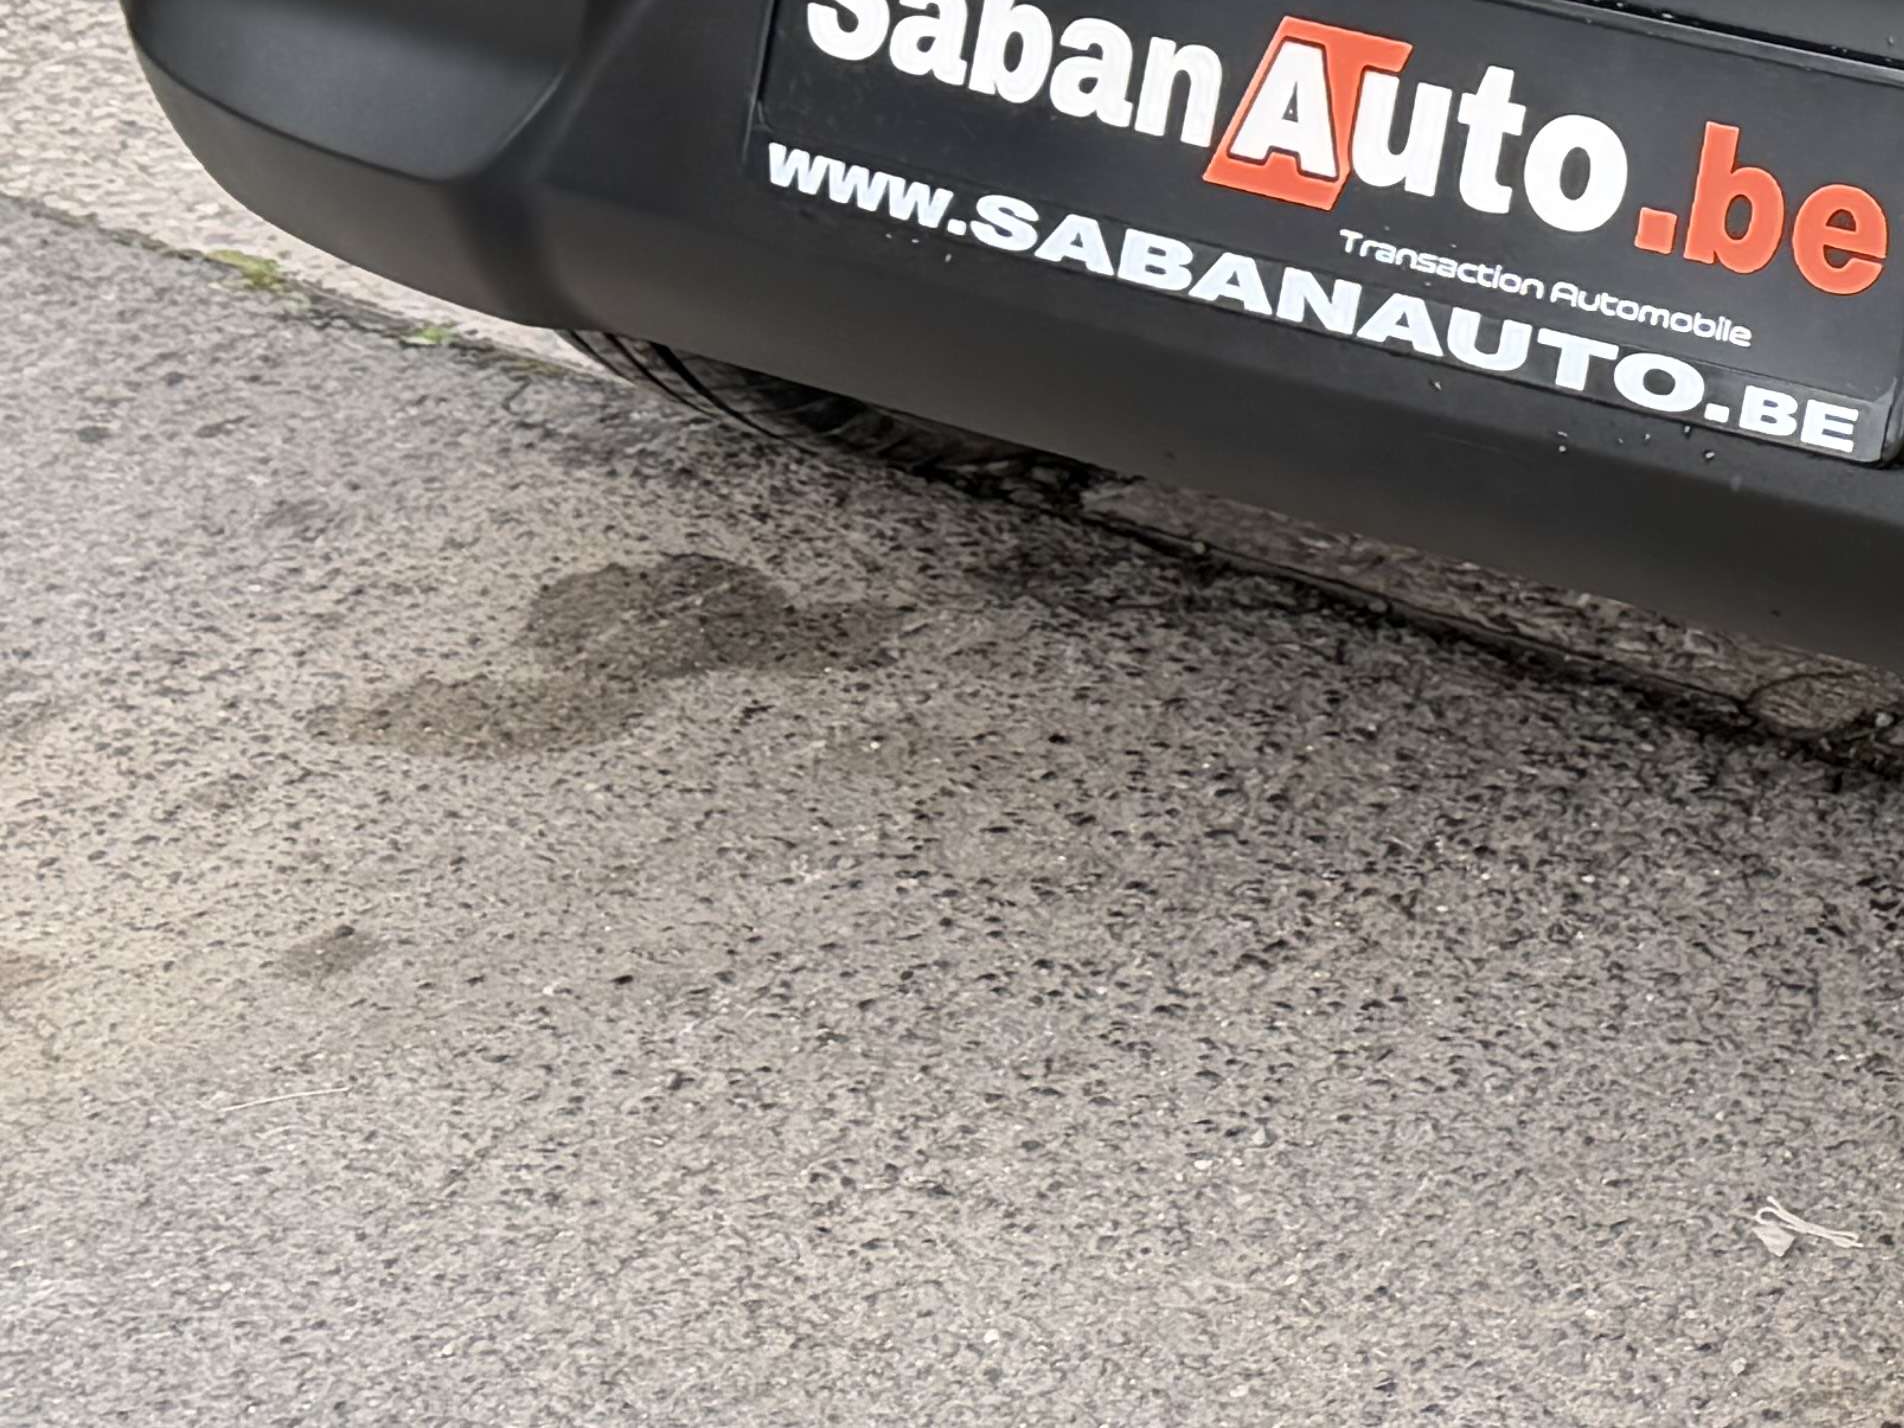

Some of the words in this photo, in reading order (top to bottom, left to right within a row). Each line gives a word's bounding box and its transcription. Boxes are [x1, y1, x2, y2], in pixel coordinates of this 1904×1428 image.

[765, 142, 1861, 455] www.SABANAUTO.BE
[1338, 230, 1546, 302] Transaction
[1550, 280, 1753, 349] Automobile
